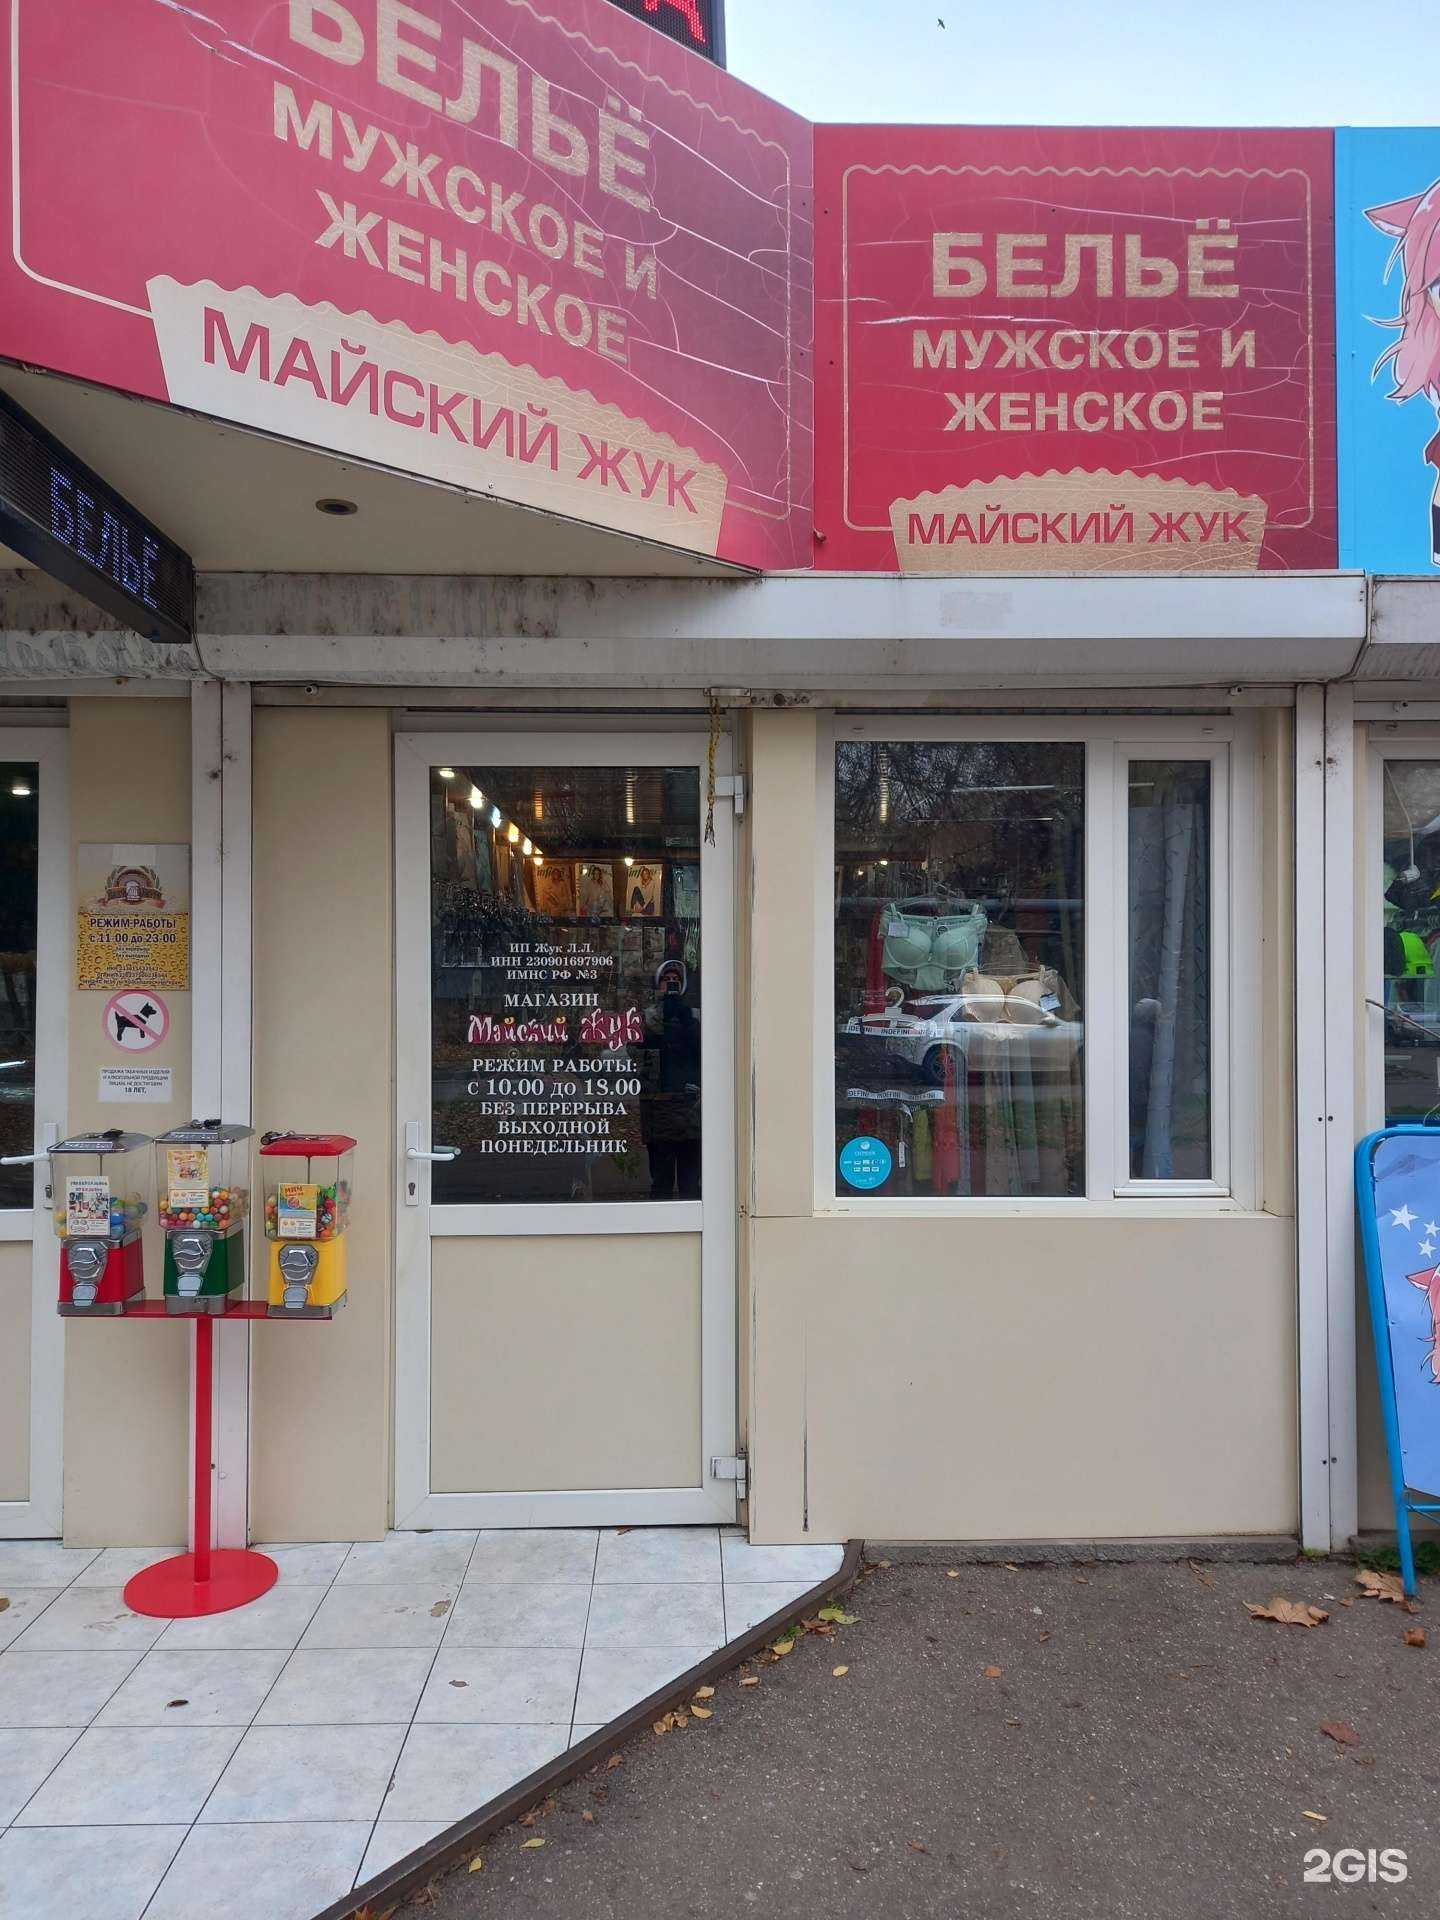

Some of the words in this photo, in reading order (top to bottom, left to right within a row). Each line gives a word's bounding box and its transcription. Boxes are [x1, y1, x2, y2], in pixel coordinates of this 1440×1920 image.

[273, 81, 605, 279] МУЖСКОЕ
[625, 244, 657, 300] И
[931, 218, 1240, 299] БЕЛЬЁ
[314, 189, 628, 364] ЖЕНСКОЕ
[912, 329, 1200, 369] МУЖСКОЕ
[1221, 329, 1256, 369] И
[203, 305, 559, 471] МАЙСКИЙ
[577, 433, 698, 514] ЖУК
[943, 391, 1224, 432] ЖЕНСКОЕ
[907, 503, 1135, 544] МАЙСКИЙ
[1147, 510, 1251, 543] ЖУК
[50, 466, 160, 609] БЕЛЬЁ
[90, 918, 130, 928] РЕЖИМ
[133, 918, 176, 928] РАБОТЫ
[509, 943, 530, 953] ИП
[535, 943, 563, 956] Жук
[567, 943, 594, 953] Л.Л.
[491, 957, 521, 966] ИНН
[526, 956, 614, 967] 230901697906
[507, 970, 548, 980] ИМНС
[551, 969, 571, 980] РФ
[576, 970, 598, 980] №3
[504, 993, 599, 1007] МАГАЗИН
[467, 1013, 569, 1044] Майский
[580, 1007, 643, 1051] Жук
[472, 1058, 545, 1073] РЕЖИМ
[552, 1058, 638, 1073] РАБОТЫ:
[487, 1078, 544, 1096] 10.00
[550, 1082, 577, 1098] до
[584, 1078, 641, 1096] 18.00
[480, 1101, 515, 1115] БЕЗ
[522, 1101, 628, 1116] ПЕРЕРЫВА
[498, 1118, 610, 1137] ВЫХОДНОЙ
[480, 1139, 628, 1156] ПОНЕДЕЛЬНИК
